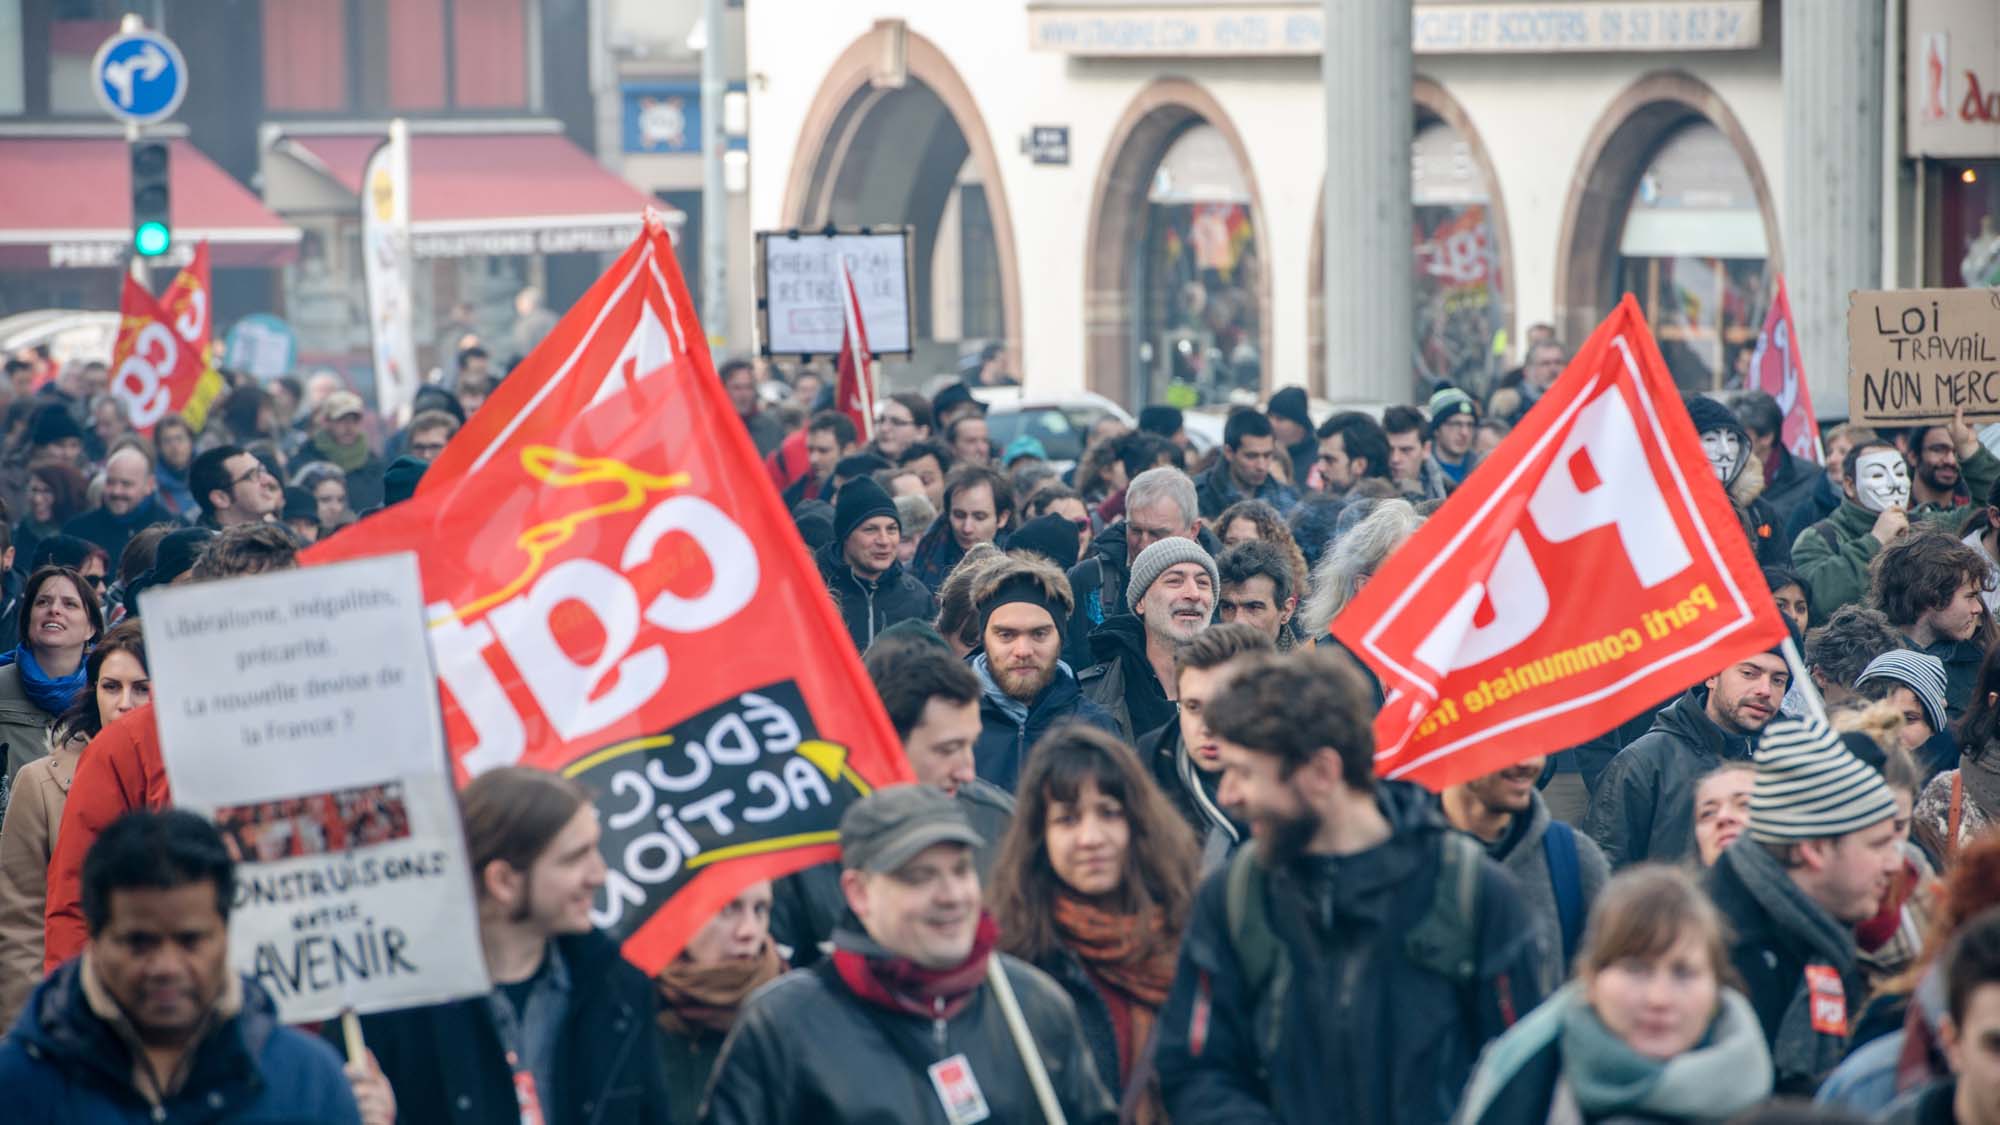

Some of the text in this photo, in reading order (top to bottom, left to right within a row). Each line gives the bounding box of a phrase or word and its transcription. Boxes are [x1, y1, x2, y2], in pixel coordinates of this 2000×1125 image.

[1863, 368, 2000, 411] NON MERC
[183, 665, 405, 717] La nouvelle devise de
[241, 725, 262, 747] la
[266, 716, 336, 742] France
[232, 851, 447, 909] ONSTRUISONS
